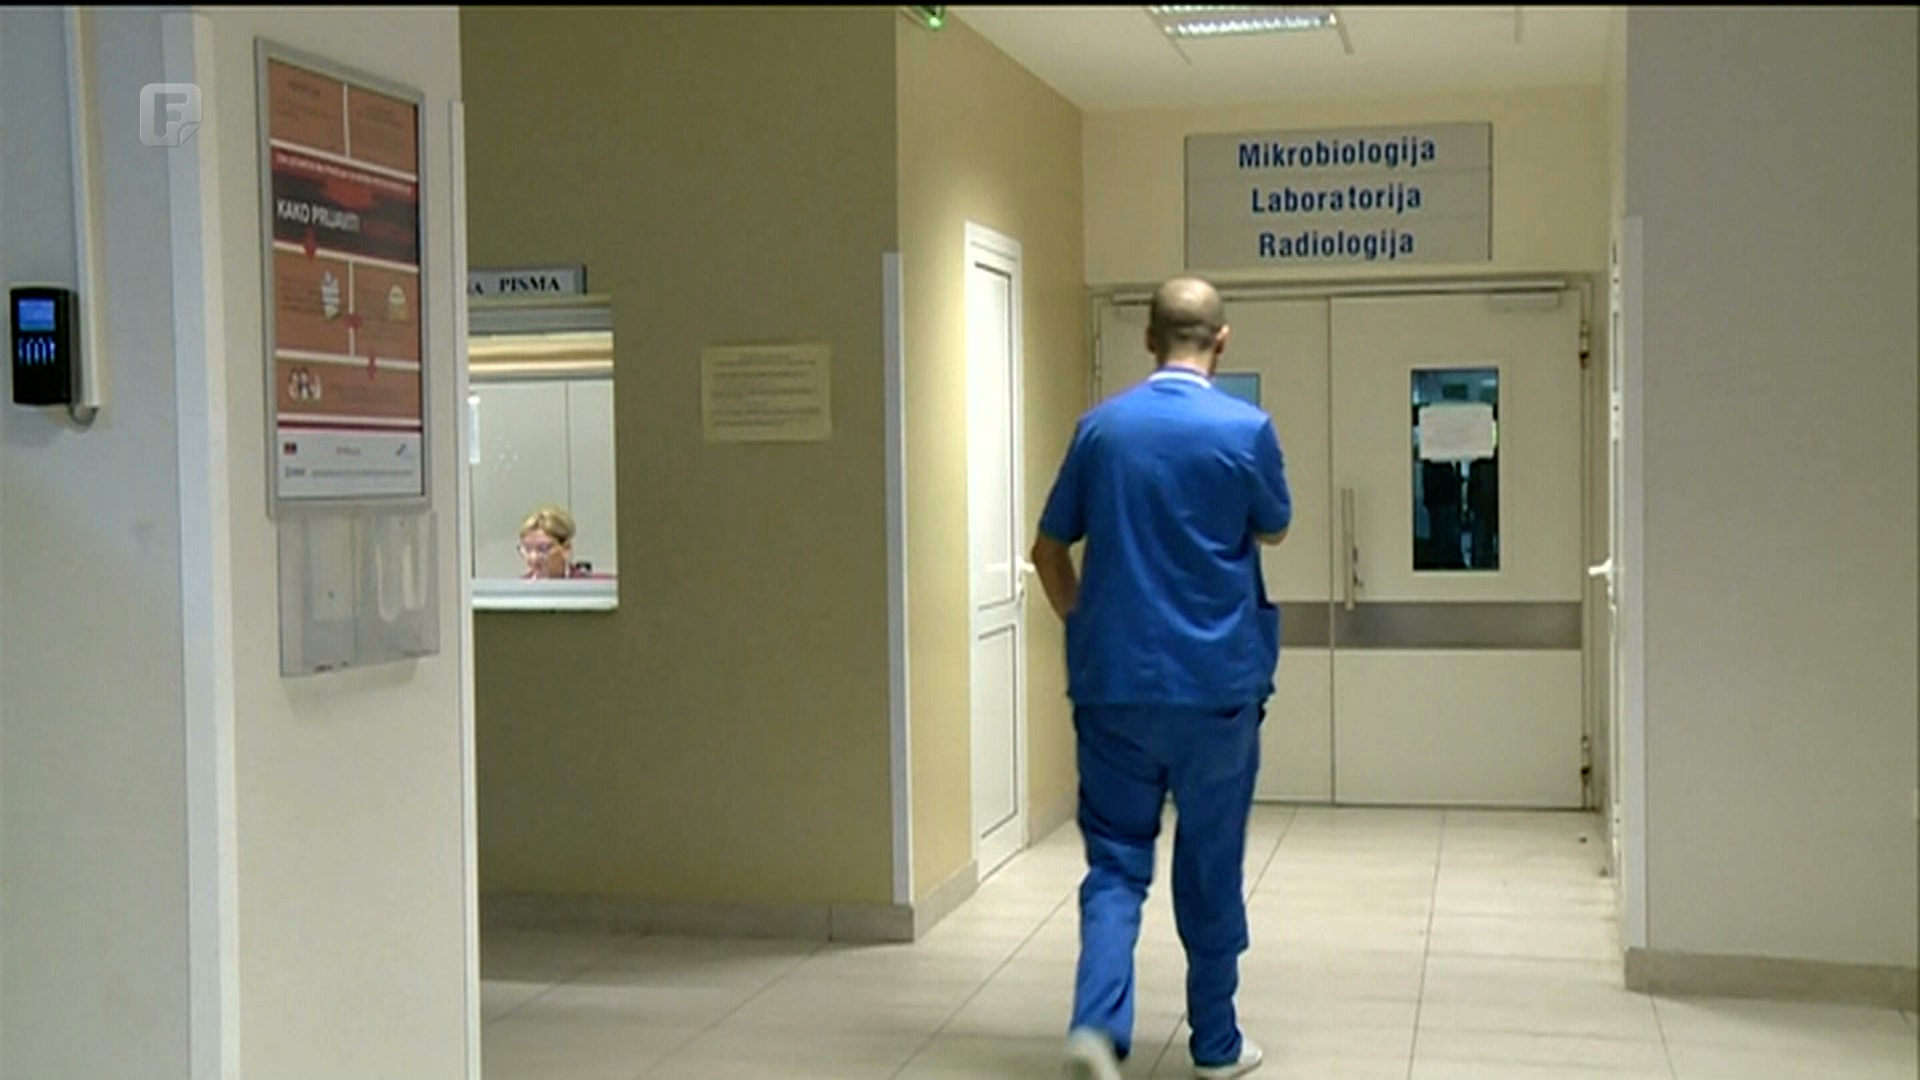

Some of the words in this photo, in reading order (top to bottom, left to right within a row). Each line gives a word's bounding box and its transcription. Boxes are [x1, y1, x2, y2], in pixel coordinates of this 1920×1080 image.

[1238, 135, 1436, 169] Mikrobiologija
[276, 198, 310, 224] KAKO
[1251, 181, 1422, 215] Laboratorija
[1258, 228, 1414, 261] Radiologija
[499, 275, 561, 292] PISMA
